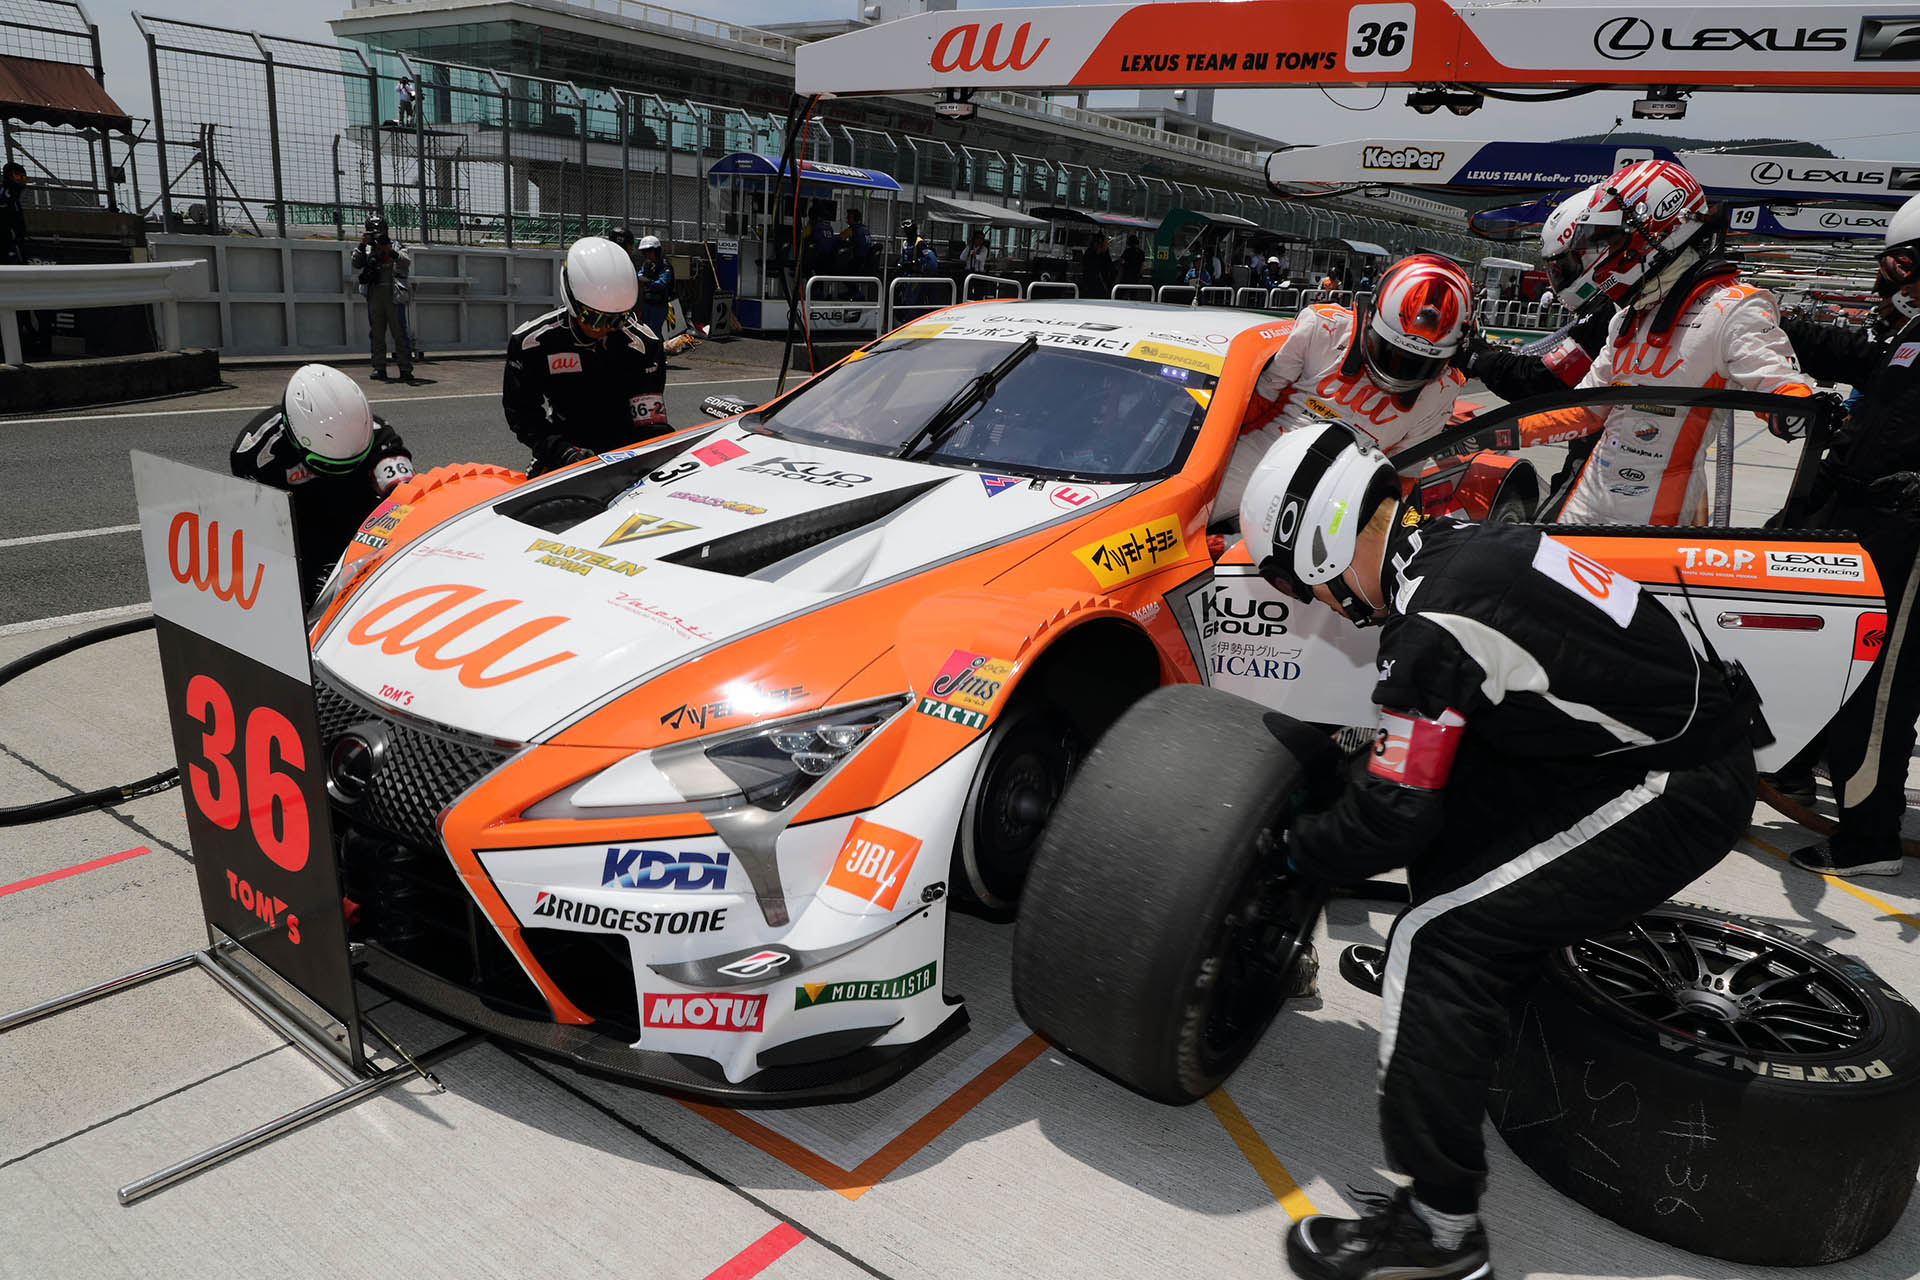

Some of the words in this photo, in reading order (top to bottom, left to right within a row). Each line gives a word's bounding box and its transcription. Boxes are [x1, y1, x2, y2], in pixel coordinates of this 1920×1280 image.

[930, 22, 1051, 72] au
[1352, 21, 1408, 58] 36
[1662, 28, 1847, 51] LEXUS
[1121, 55, 1179, 72] LEXUS
[1186, 54, 1236, 71] TEAM
[1242, 53, 1268, 70] au
[1275, 52, 1337, 70] TOM'S
[1364, 147, 1445, 170] KeePer
[1467, 171, 1500, 181] LEXUS
[1503, 172, 1532, 182] TEAM
[1534, 173, 1572, 183] KeePer
[1787, 168, 1884, 185] LEXUS
[1735, 210, 1755, 224] 19
[716, 302, 728, 329] 2
[809, 312, 843, 321] EXUS
[551, 356, 579, 370] au
[1612, 342, 1685, 379] au
[704, 396, 744, 414] EDIFICE
[1316, 372, 1399, 425] au
[706, 407, 729, 420] CASIO
[383, 463, 408, 479] 36
[737, 465, 854, 489] GROUP
[752, 456, 874, 484] KUO
[1623, 468, 1643, 479] Arai
[1262, 495, 1282, 534] GIRO
[354, 532, 386, 549] TACTI
[168, 511, 264, 610] au
[524, 538, 649, 577] VANTELIN
[534, 556, 594, 577] KOWA
[1770, 553, 1858, 567] LEXUS
[1770, 564, 1816, 574] GAZOO
[1817, 566, 1860, 578] Racing
[1202, 586, 1290, 624] KUO
[347, 584, 579, 689] au
[378, 684, 415, 706] TOM'S
[923, 698, 985, 729] TACTI
[186, 674, 310, 873] 36
[601, 847, 730, 890] KDDI
[226, 868, 301, 945] TOM'S
[533, 892, 728, 935] BRIDGESTONE
[831, 969, 932, 1001] MODELLISTA
[649, 998, 759, 1028] MOTUL
[1657, 1032, 1894, 1084] POTENZA
